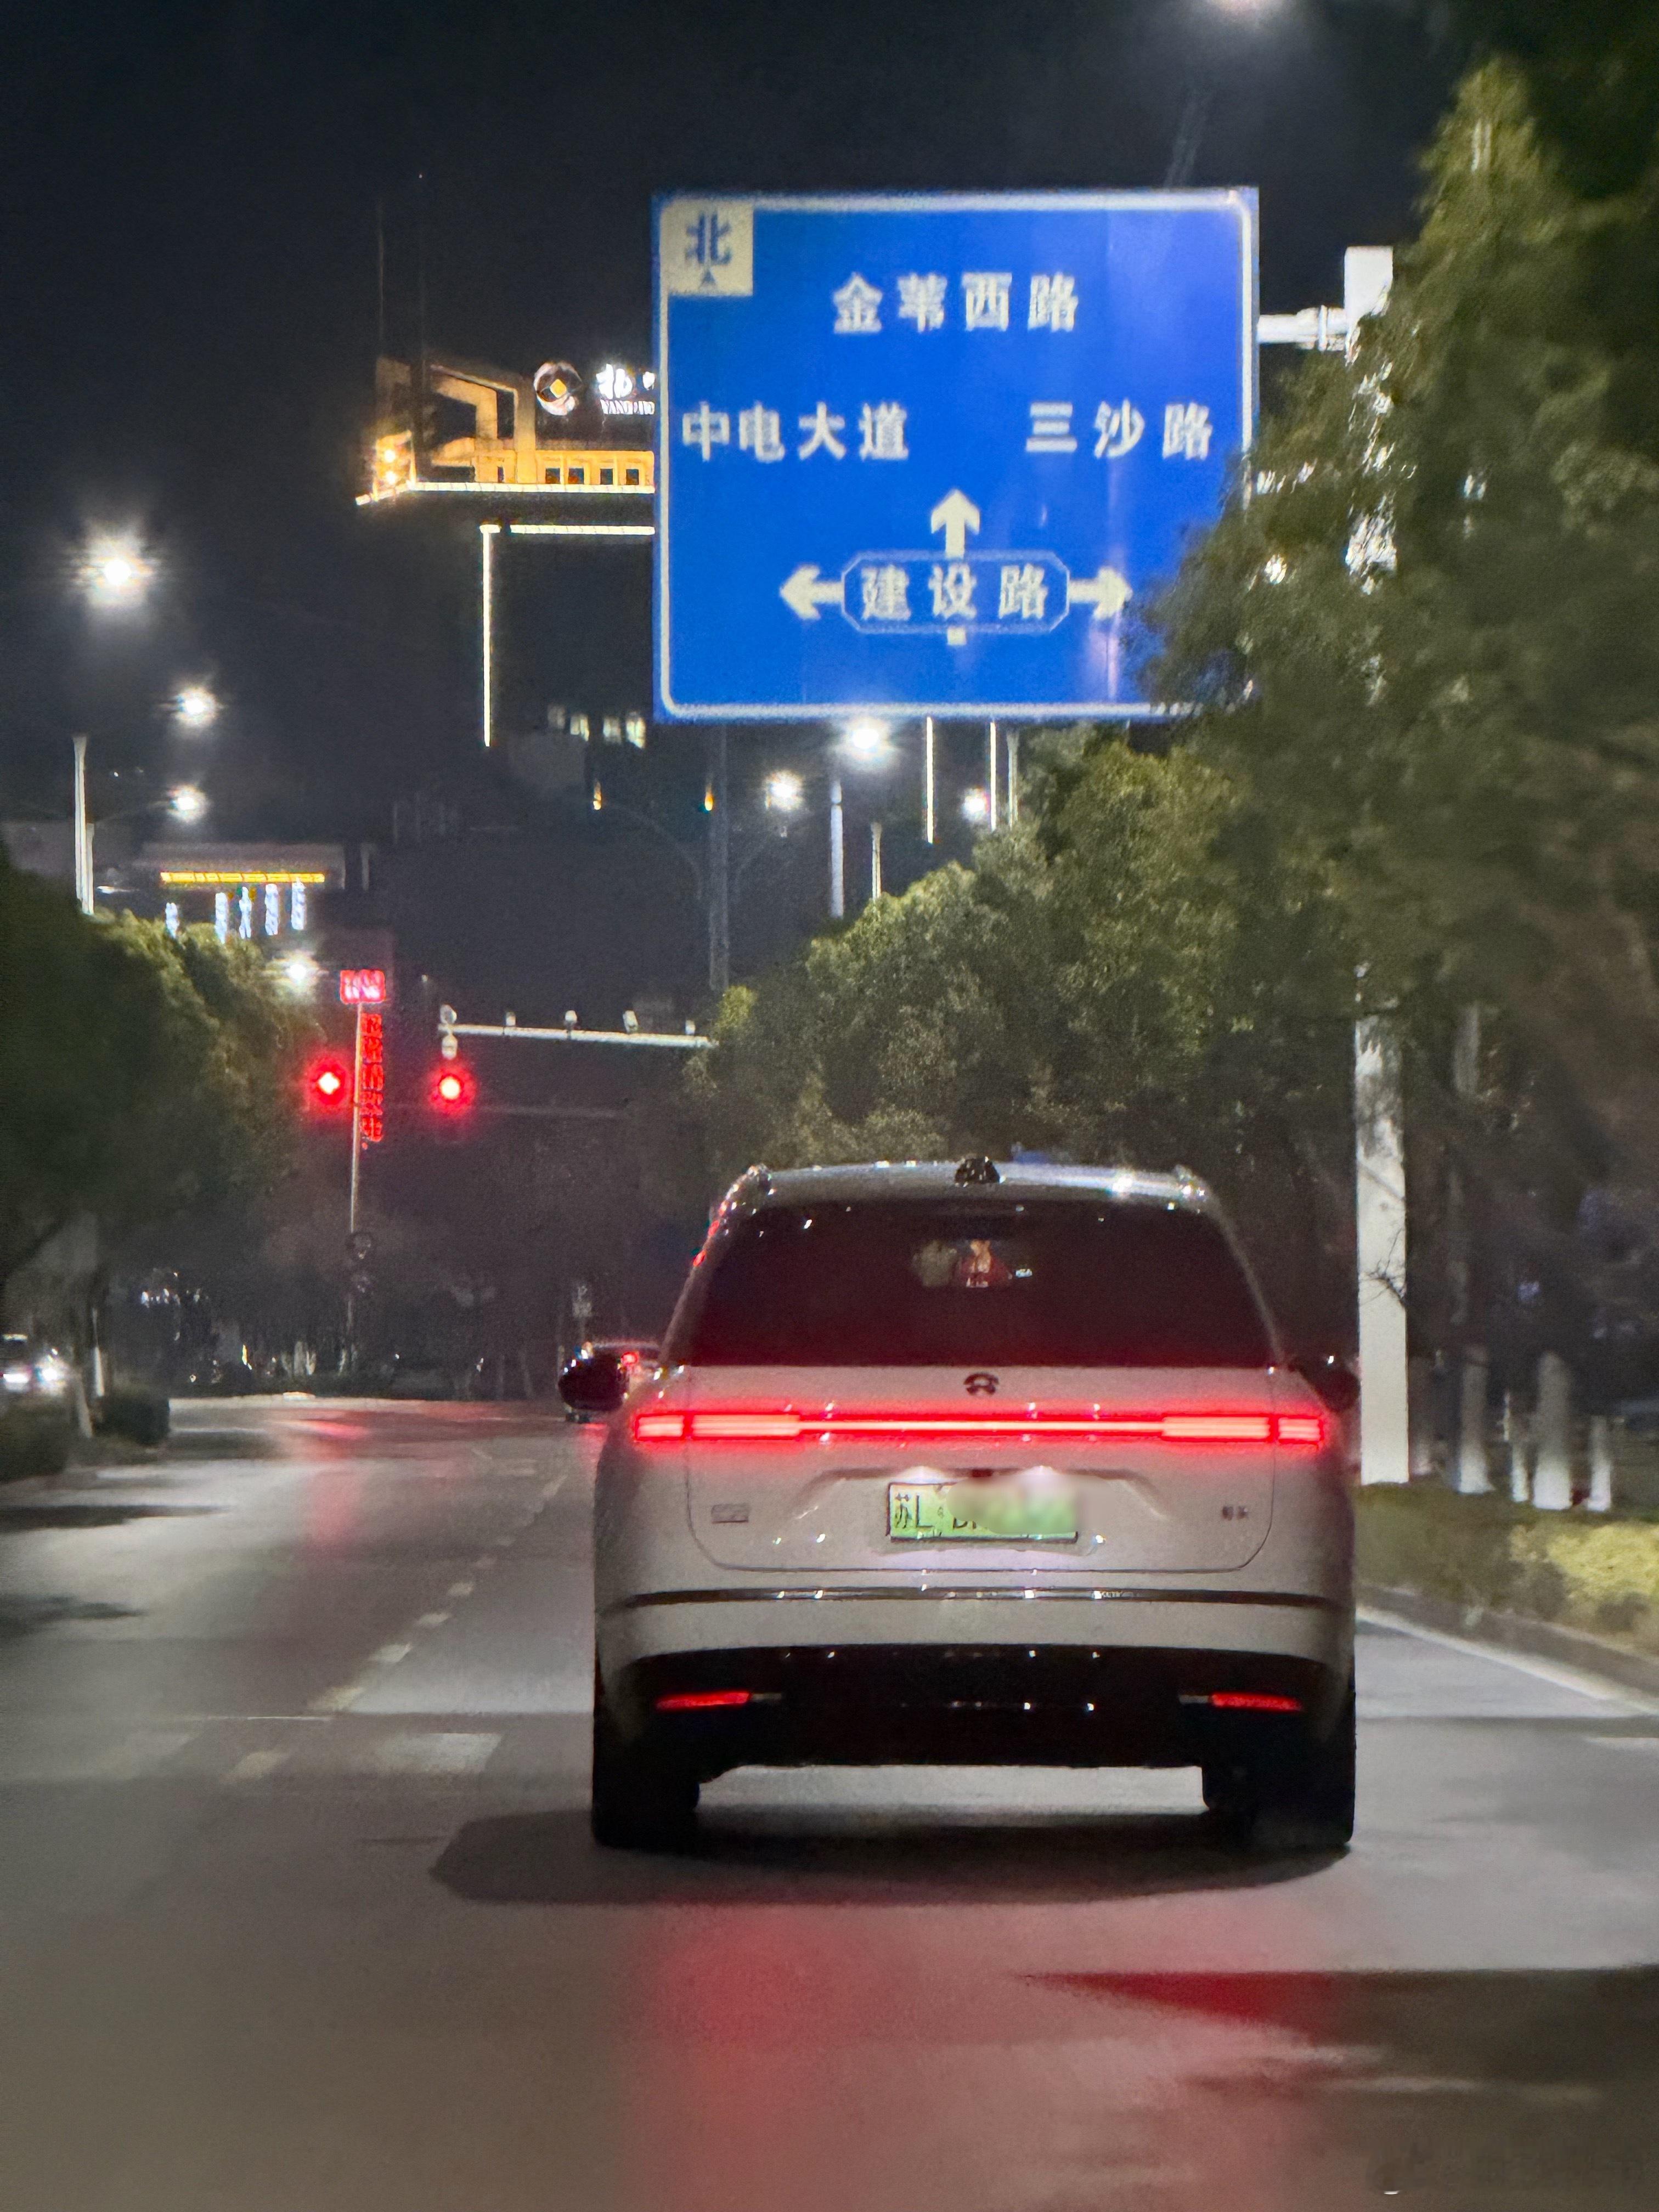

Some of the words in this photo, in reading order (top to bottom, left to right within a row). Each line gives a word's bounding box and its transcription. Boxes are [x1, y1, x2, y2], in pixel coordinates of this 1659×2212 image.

[685, 211, 732, 264] 北
[682, 402, 909, 461] 中电大道
[1025, 399, 1214, 460] 三沙路
[860, 562, 1049, 621] 建设路
